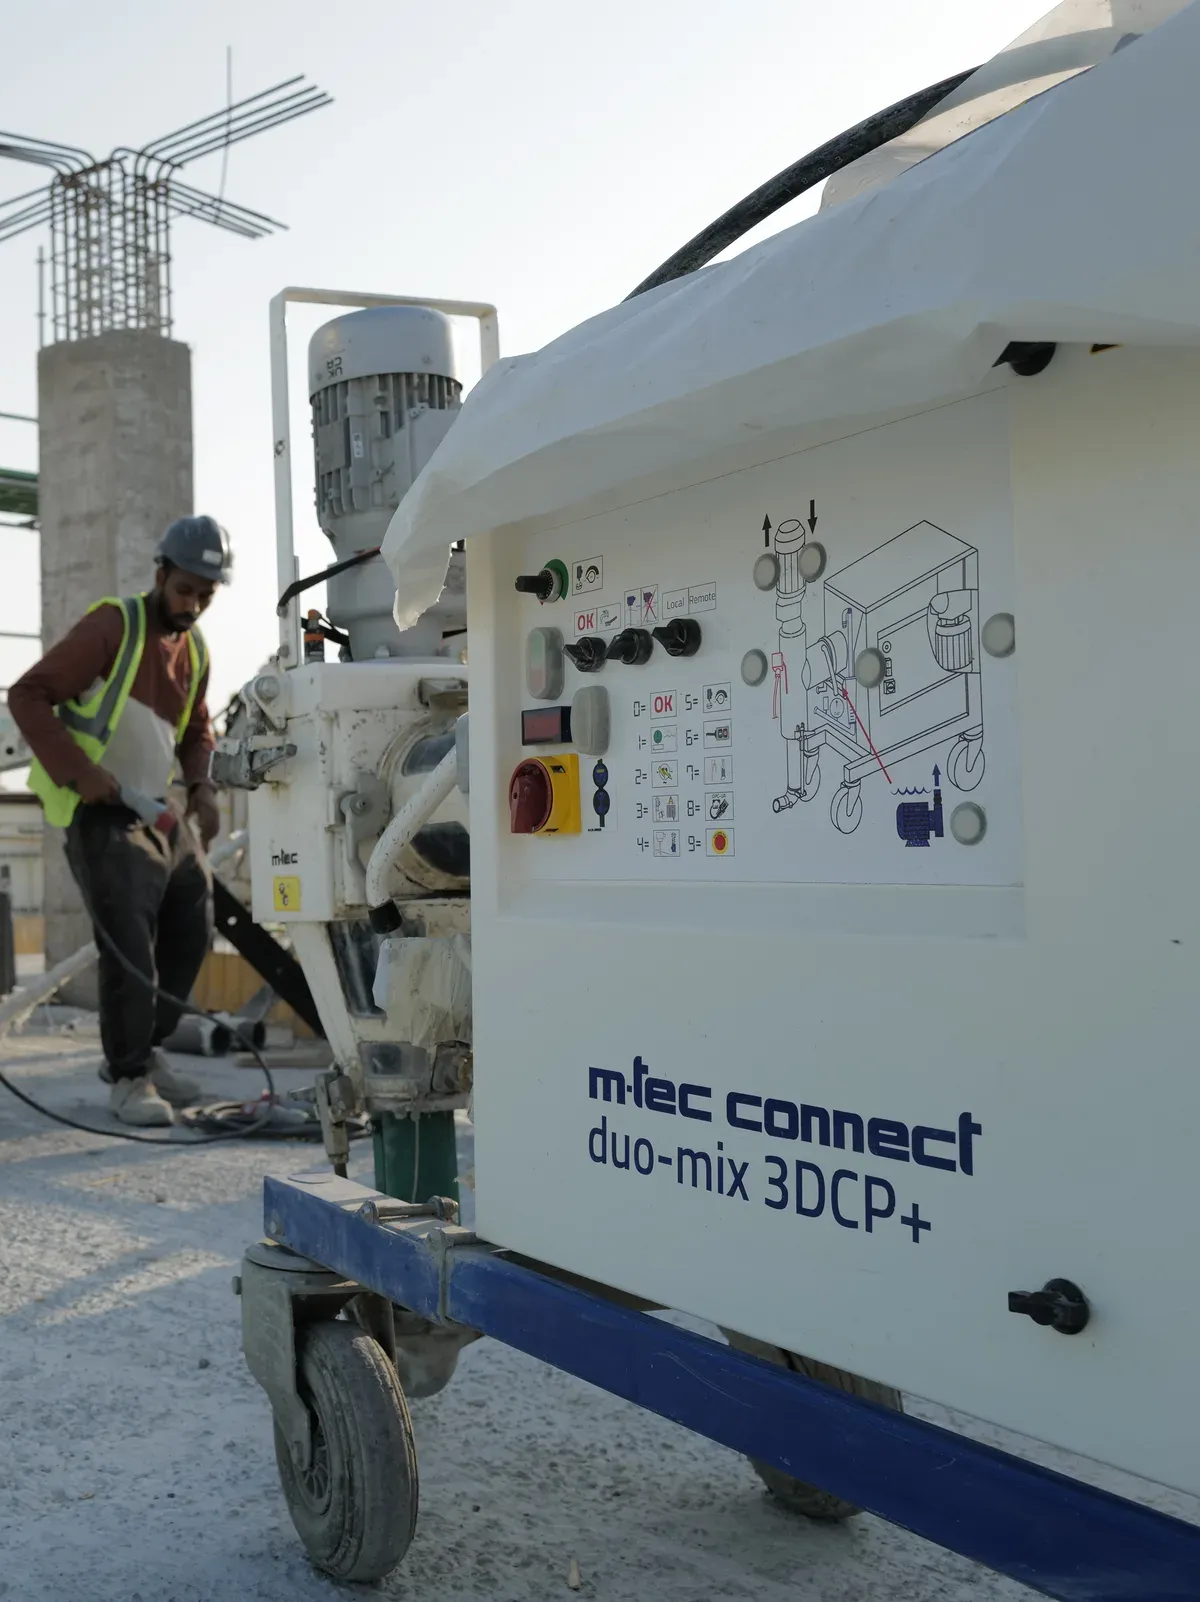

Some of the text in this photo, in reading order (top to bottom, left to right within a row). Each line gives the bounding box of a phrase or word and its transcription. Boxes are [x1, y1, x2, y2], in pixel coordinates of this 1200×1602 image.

[666, 597, 685, 610] Local
[689, 592, 717, 605] Remote
[577, 613, 594, 631] OK
[654, 695, 673, 713] OK
[726, 1091, 982, 1177] connect
[588, 1115, 931, 1244] duo-mix 3DCP+
